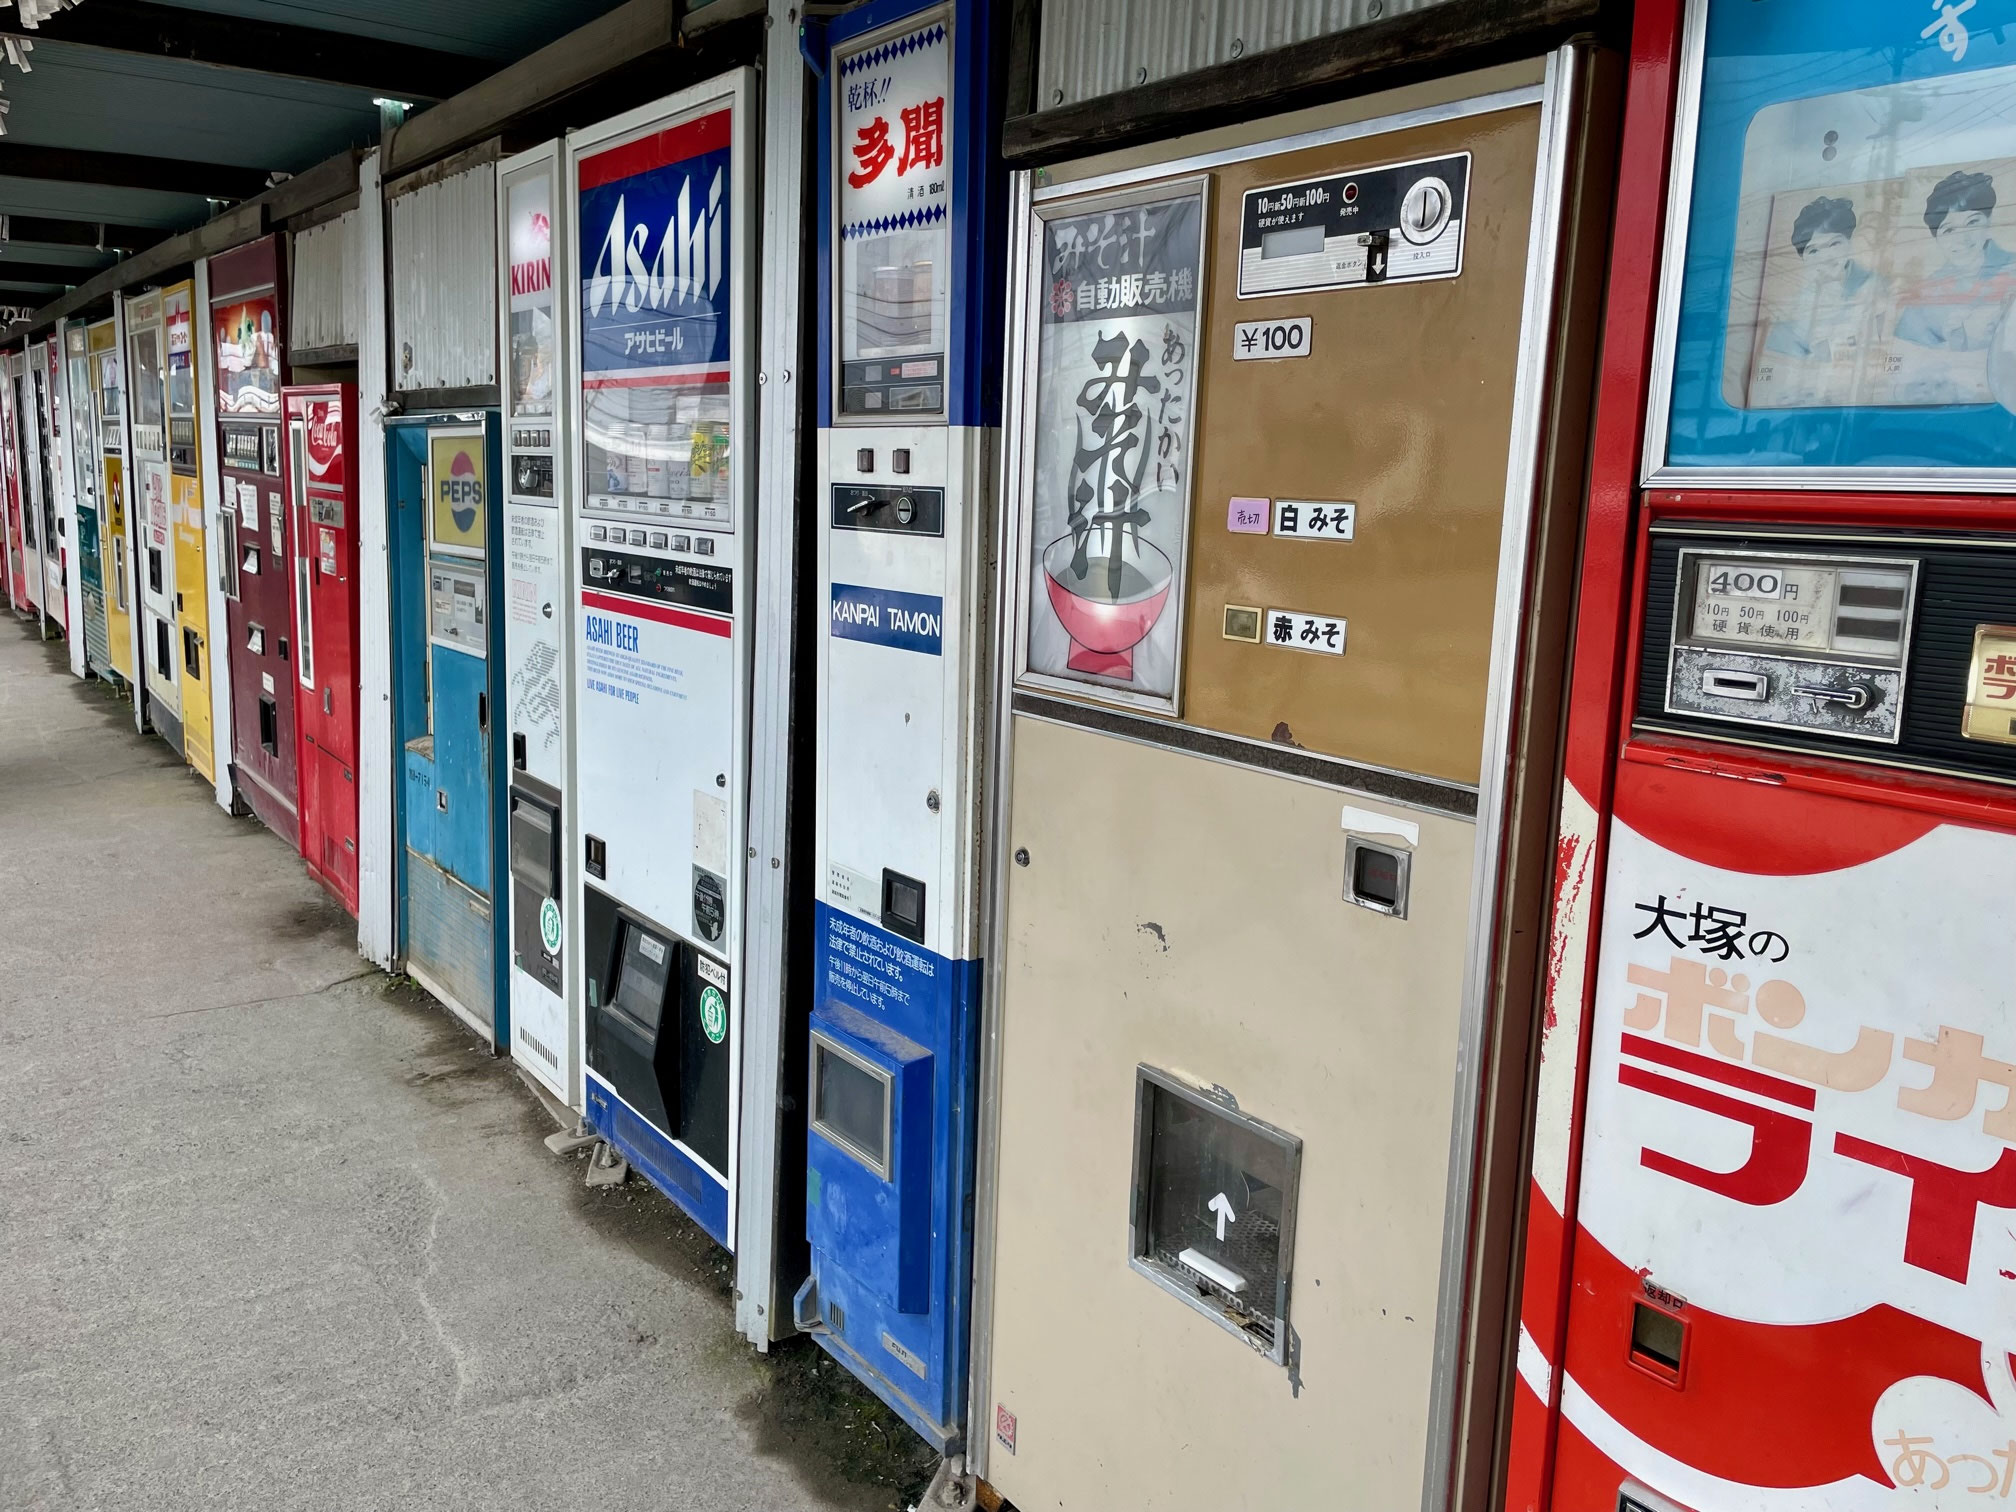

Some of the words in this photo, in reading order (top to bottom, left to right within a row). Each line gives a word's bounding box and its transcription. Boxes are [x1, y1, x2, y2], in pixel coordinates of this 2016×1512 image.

[847, 96, 945, 190] 多聞
[907, 185, 925, 200] 清酒
[1339, 205, 1359, 217] 発売中
[1258, 212, 1305, 228] 硬貨が使えます
[589, 165, 722, 319] Asahi
[1052, 206, 1156, 275] みそ汁
[511, 257, 552, 296] KIRIN
[1076, 267, 1193, 311] 自動販売機
[624, 326, 684, 356] アサヒビール
[1241, 324, 1304, 353] ¥100
[1156, 326, 1186, 492] あったかい
[1237, 509, 1260, 525] 売切
[832, 600, 879, 628] KANPAI
[887, 607, 941, 638] TAMON
[1706, 603, 1730, 617] 10円
[1739, 606, 1765, 620] 50円
[1776, 609, 1809, 625] 100円
[586, 615, 612, 646] ASAHI
[616, 620, 639, 653] BEER
[829, 917, 935, 977] 未成年者の飲酒および飲酒運転は
[1633, 894, 1790, 963] 大塚の
[828, 933, 903, 982] 法律で禁止されています。
[828, 970, 886, 1011] 販売を停止しています。
[1643, 1283, 1683, 1309] 返却口
